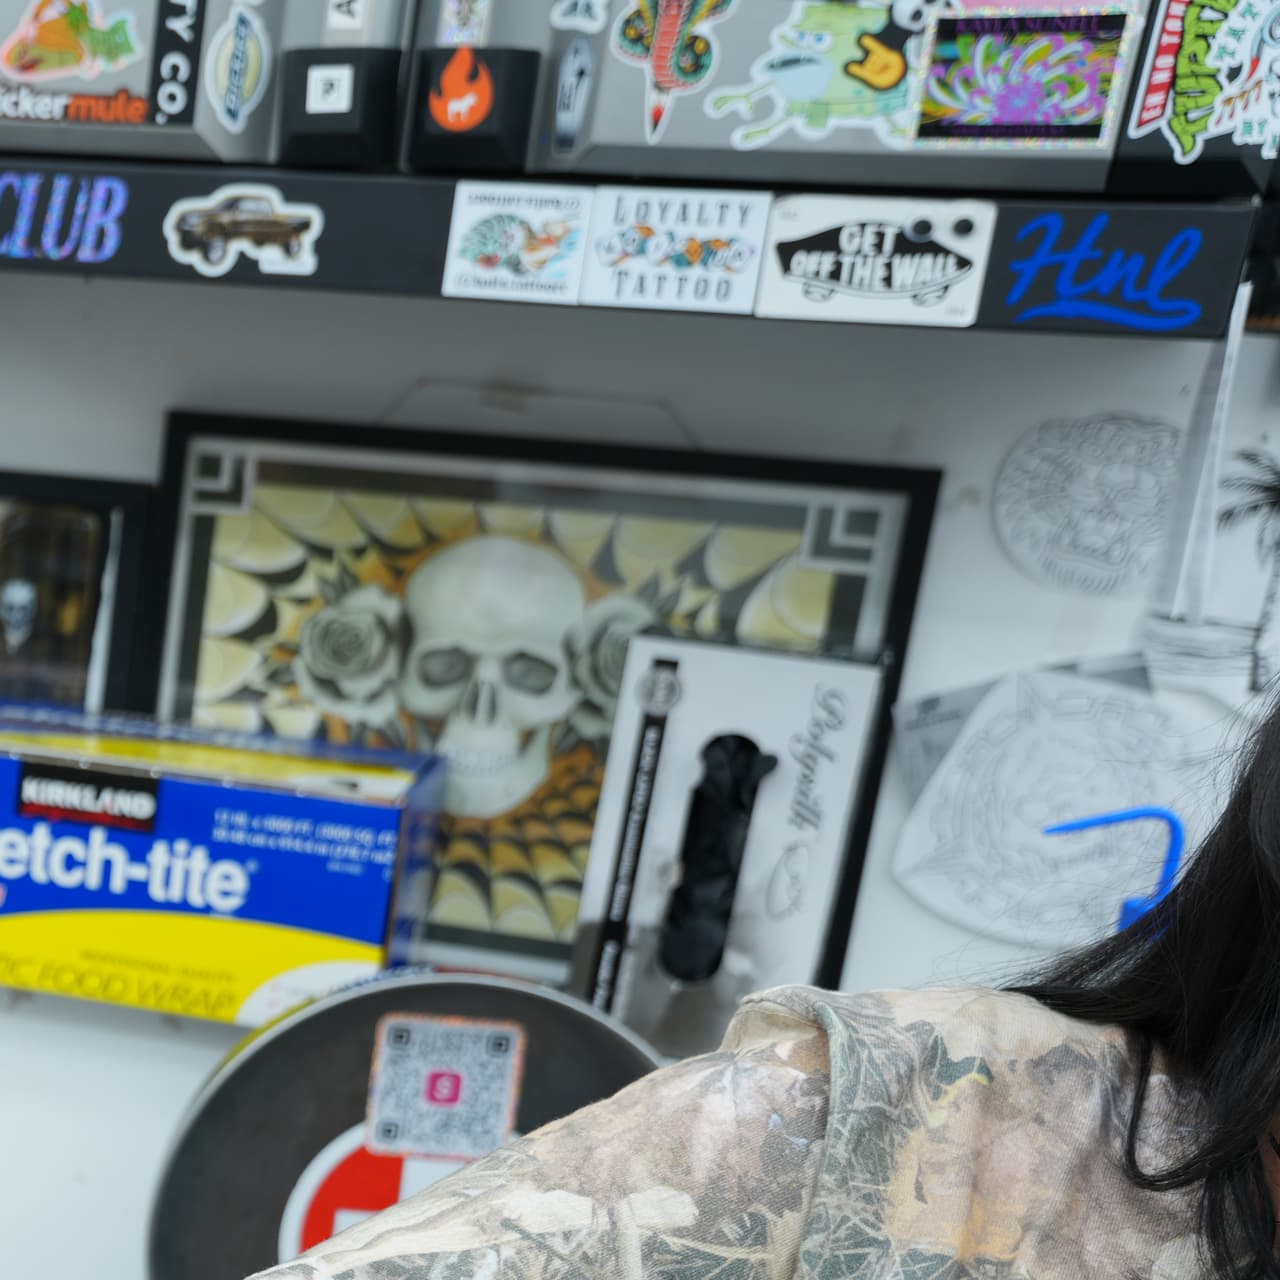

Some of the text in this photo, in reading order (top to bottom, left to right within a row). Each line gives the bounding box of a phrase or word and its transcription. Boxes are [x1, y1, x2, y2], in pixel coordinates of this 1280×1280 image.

[616, 195, 751, 227] LOYALTY
[838, 223, 902, 256] GET
[614, 269, 734, 302] TATTOO
[839, 254, 891, 292] THE
[890, 252, 960, 291] WALL
[20, 776, 157, 821] KIRKLAND
[36, 961, 130, 1000] FOOD
[135, 975, 236, 1017] WRAP
